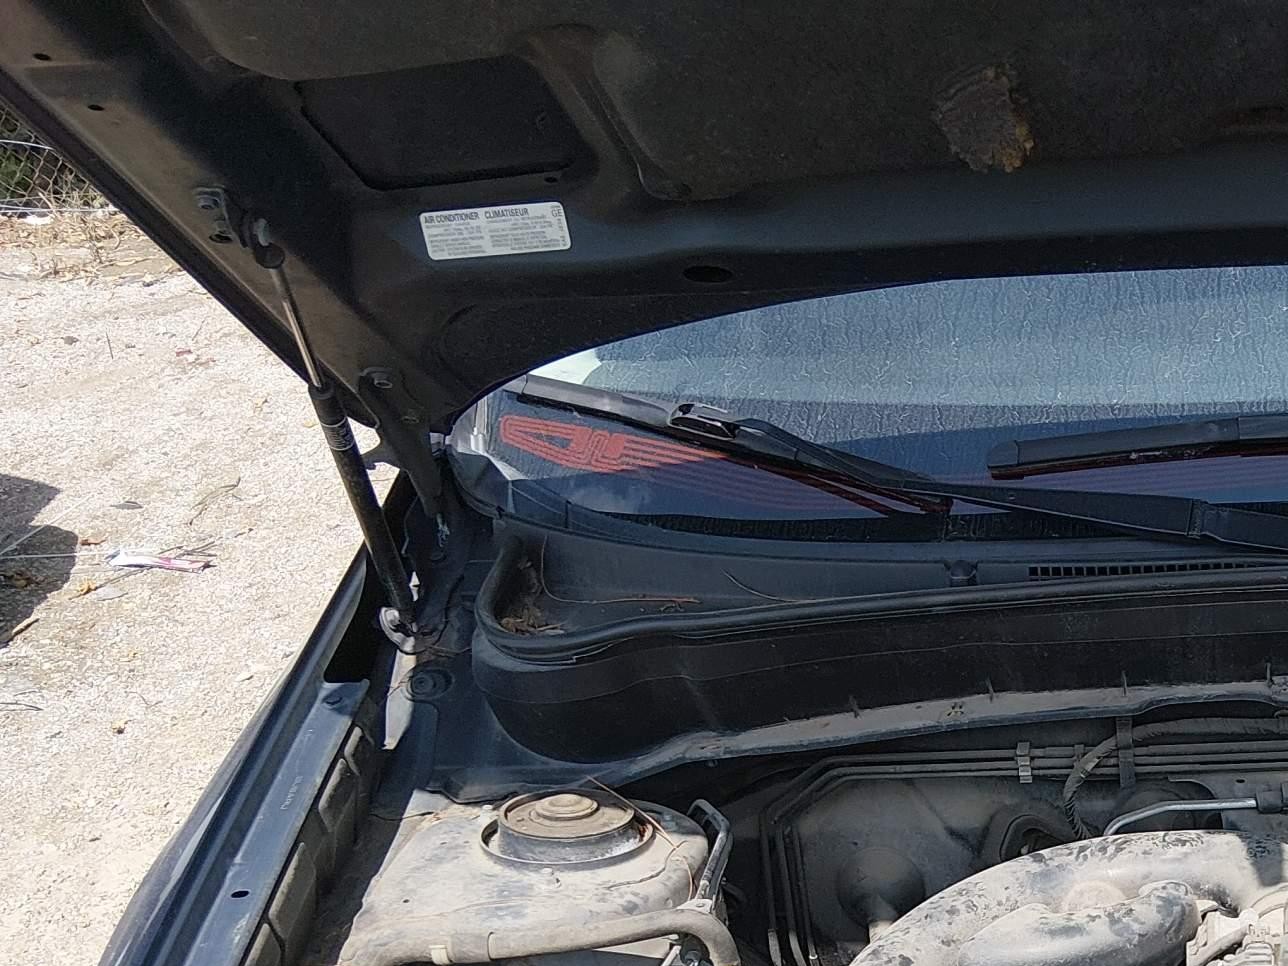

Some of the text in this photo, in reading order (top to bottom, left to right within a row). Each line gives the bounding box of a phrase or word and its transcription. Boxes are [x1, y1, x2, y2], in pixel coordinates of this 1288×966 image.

[424, 208, 529, 224] AIR CONDITIONER CLIMATISEUR
[551, 208, 563, 217] GE
